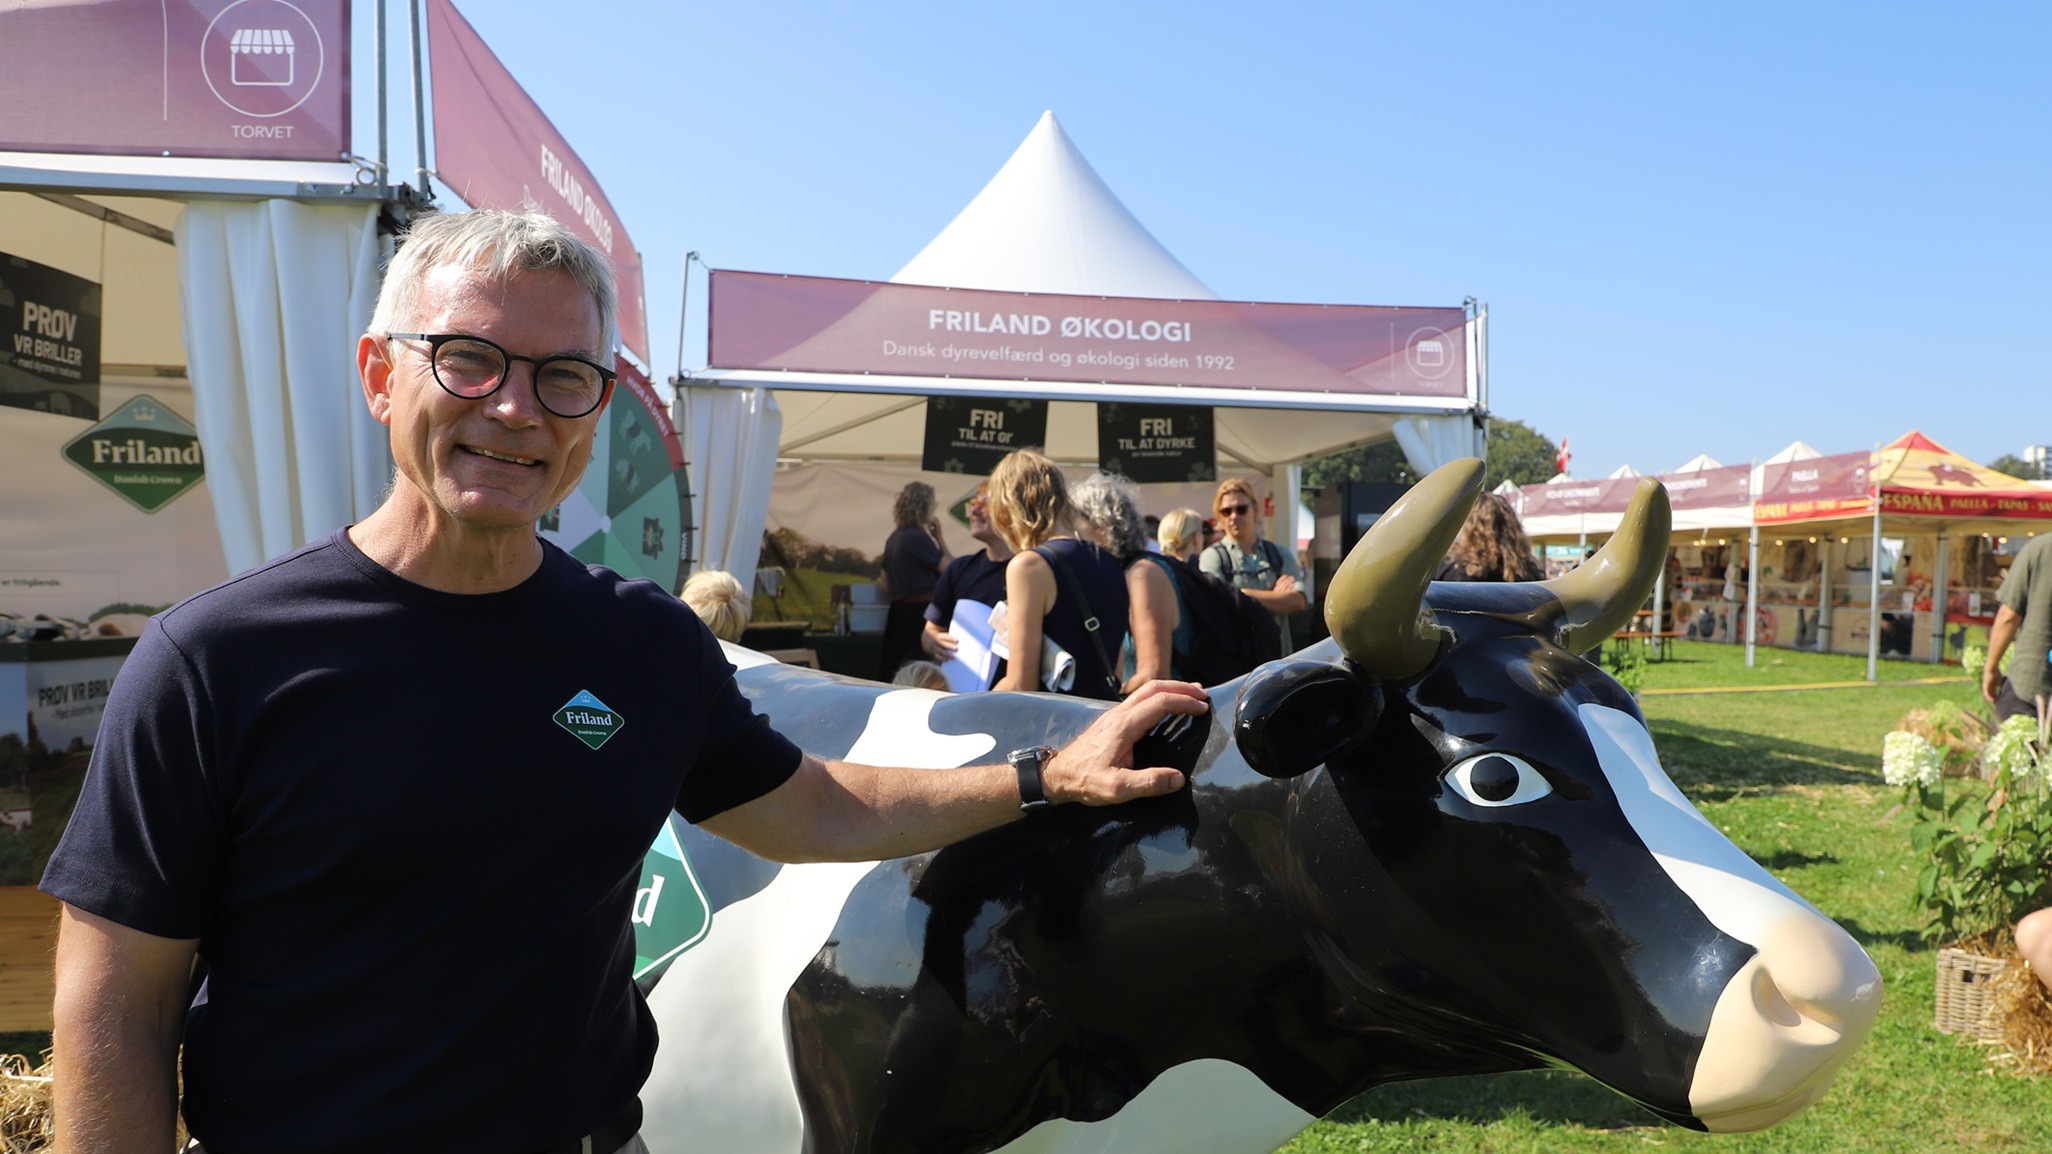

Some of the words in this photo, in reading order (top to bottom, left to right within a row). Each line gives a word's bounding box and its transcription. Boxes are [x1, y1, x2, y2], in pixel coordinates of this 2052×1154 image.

[231, 125, 294, 139] TORVET
[541, 143, 584, 215] FRILAND
[23, 301, 77, 341] PRØV
[929, 309, 1051, 336] FRILAND
[1061, 316, 1191, 342] ØKOLOGI
[14, 334, 33, 355] VR
[34, 339, 82, 366] BRILLER
[883, 341, 935, 357] Dansk
[942, 343, 1043, 363] dyrevelfærd
[1050, 351, 1072, 367] og
[1077, 350, 1139, 370] økologi
[1145, 354, 1189, 369] siden
[1197, 355, 1235, 370] 1992
[970, 408, 1004, 430] FRI
[1140, 418, 1172, 436] FRI
[958, 427, 977, 441] TIL
[979, 430, 996, 443] AT
[1118, 438, 1137, 450] TIL
[1139, 438, 1154, 449] AT
[1156, 437, 1195, 449] DYRKE
[92, 439, 200, 465] Friland
[1882, 491, 1943, 511] ESPAÑA
[1951, 498, 1987, 510] PAELLA
[1998, 498, 2028, 511] TAPAS
[39, 684, 70, 707] PRØV
[71, 682, 86, 701] VR
[565, 711, 613, 726] Friland
